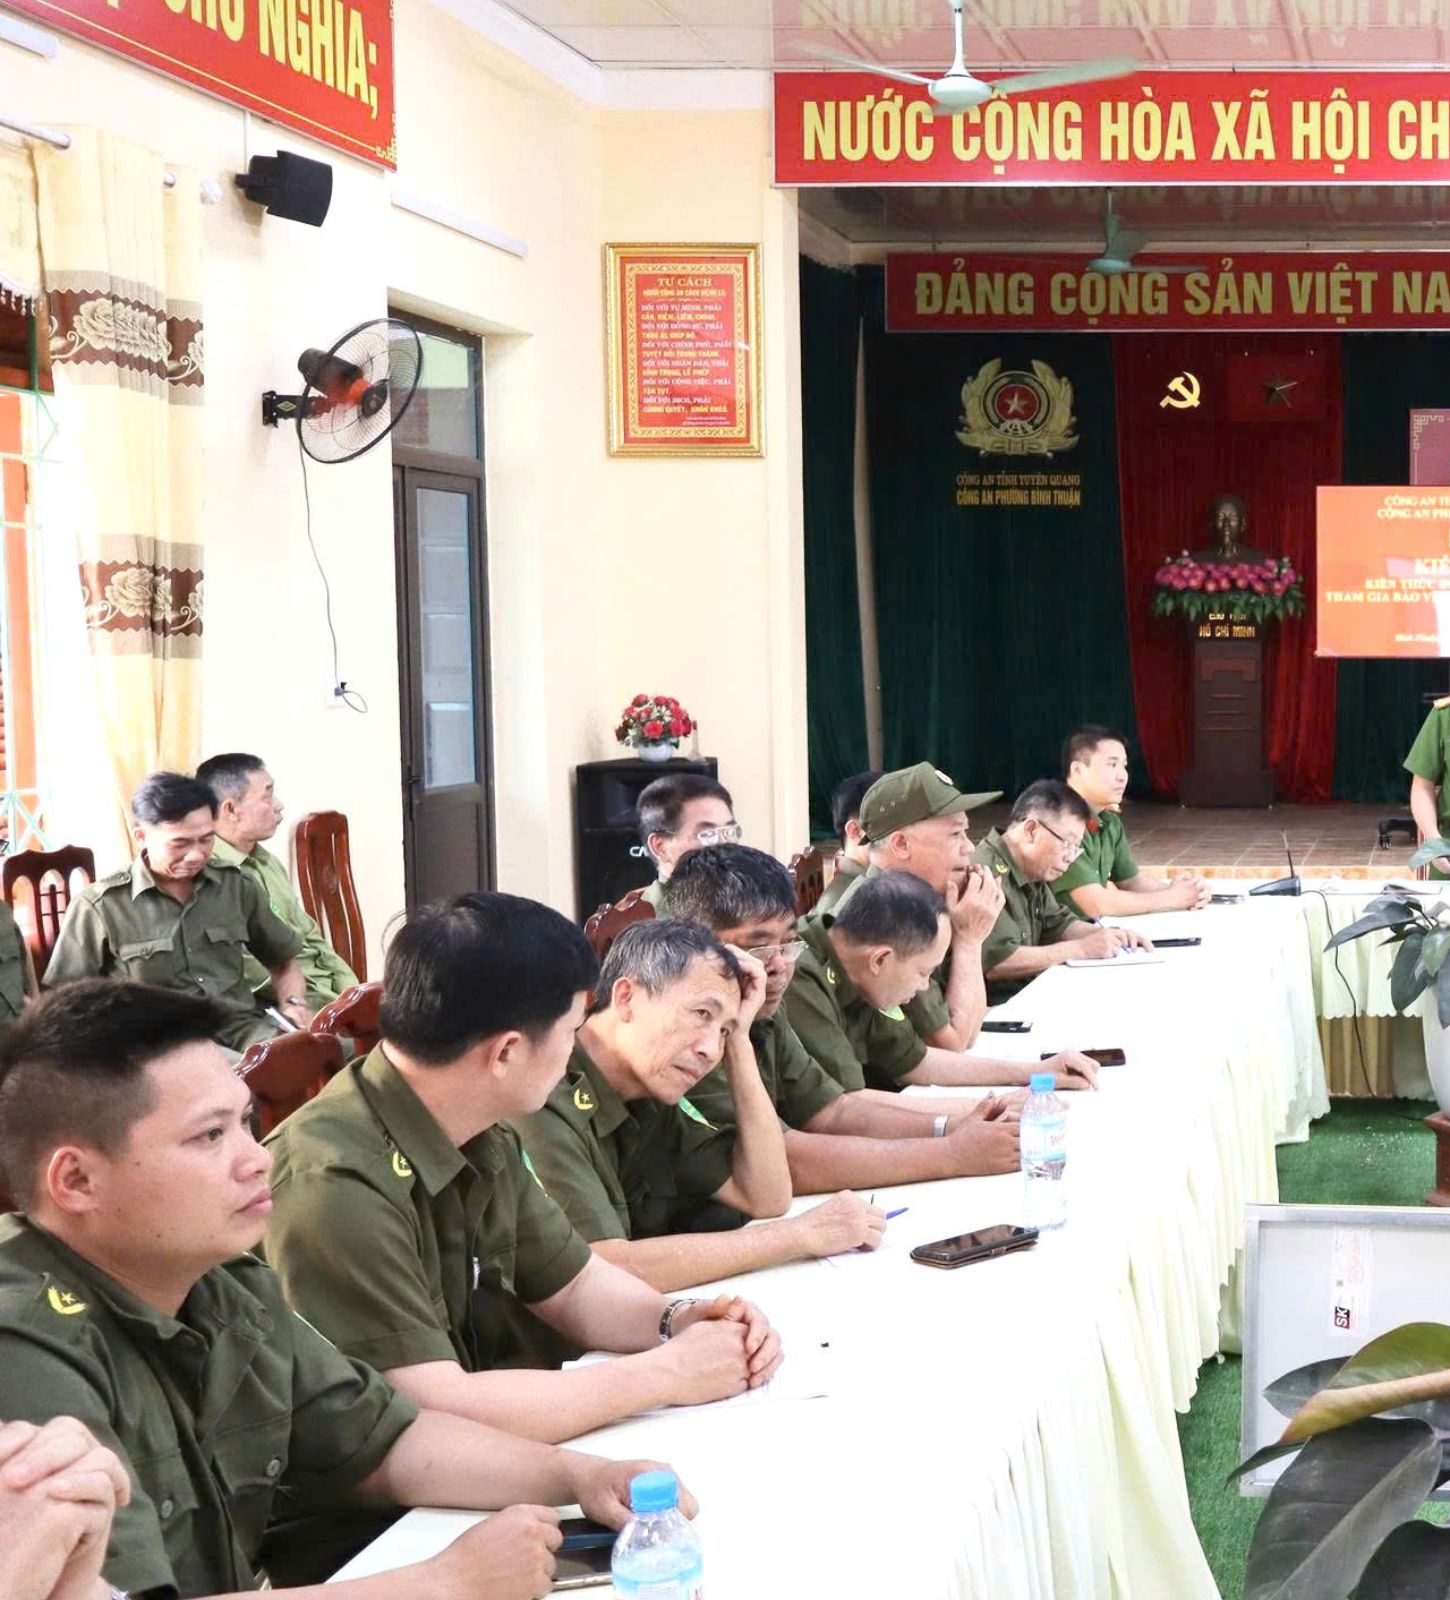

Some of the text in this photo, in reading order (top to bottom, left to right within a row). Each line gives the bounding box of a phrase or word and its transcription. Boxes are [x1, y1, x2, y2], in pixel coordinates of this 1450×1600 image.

[803, 88, 934, 161] NƯỚC
[952, 86, 1082, 175] CỘNG
[1100, 86, 1196, 161] HÒA
[1211, 88, 1276, 161] XÃ
[1292, 88, 1369, 174] HỘI
[678, 275, 713, 287] CÁCH
[916, 258, 1034, 315] ĐẢNG
[1184, 257, 1273, 315] SẢN
[1288, 262, 1377, 323] VIỆT
[956, 471, 980, 486] CÔNG
[982, 474, 996, 486] AN
[1019, 471, 1048, 486] TUYÊN
[1049, 474, 1081, 486] QUANG
[956, 487, 980, 505] CÔNG
[981, 490, 994, 505] AN
[1384, 494, 1418, 507] CÔNG
[1419, 496, 1437, 506] AN
[1377, 506, 1412, 520] CÔNG
[1413, 508, 1430, 519] AN
[1325, 591, 1364, 603] THAM
[1367, 591, 1391, 603] GIA
[1392, 589, 1421, 603] BẢO
[1215, 623, 1230, 637] CHÍ
[1232, 625, 1256, 637] MINH
[629, 846, 649, 857] CA
[1335, 1307, 1349, 1328] SK
